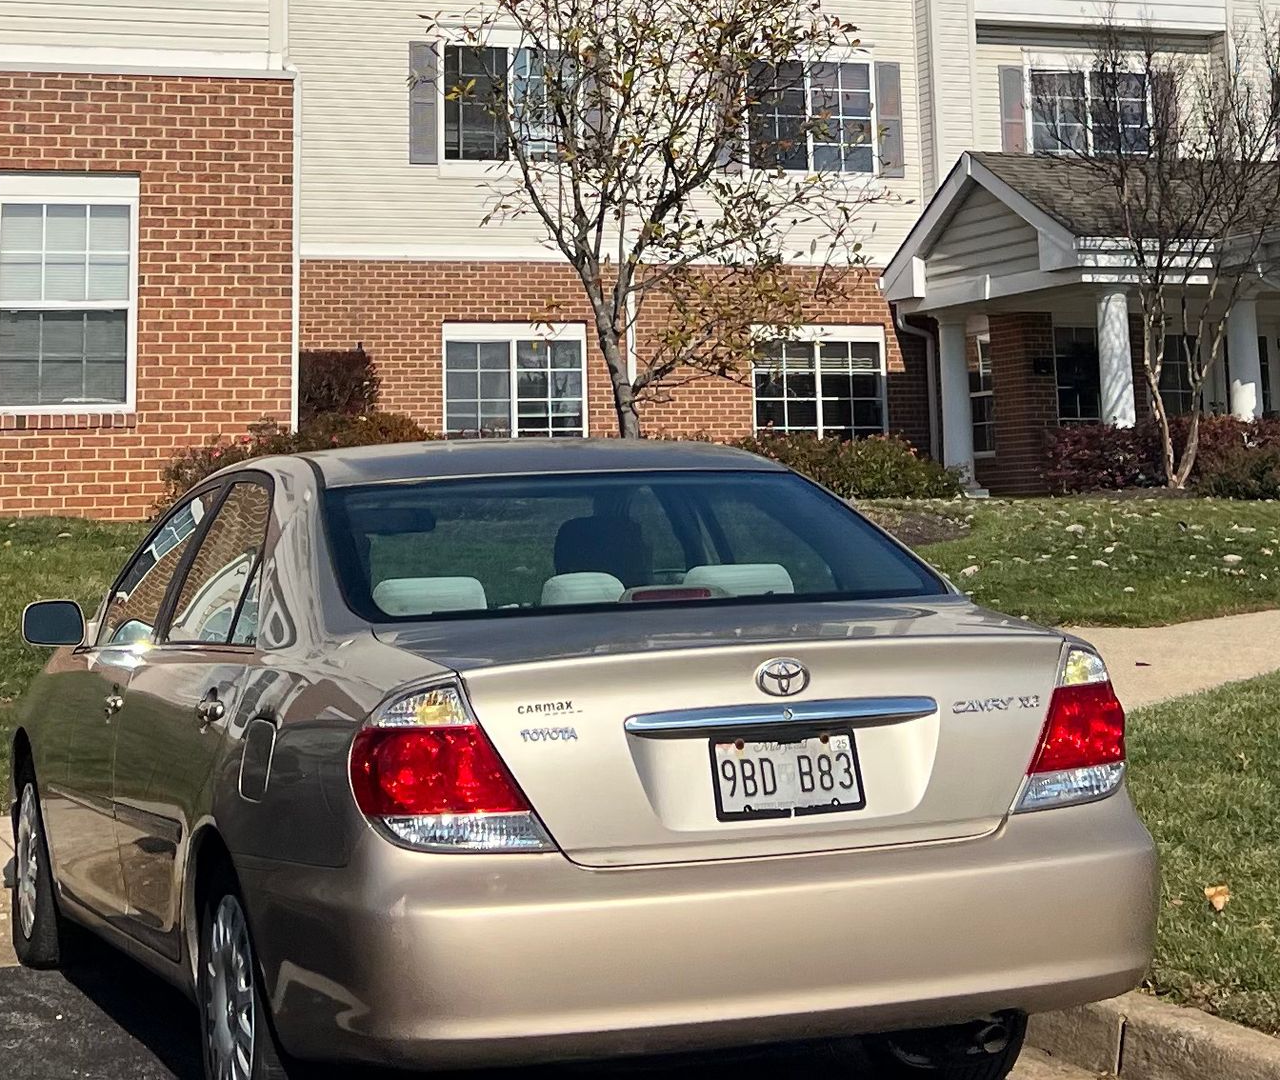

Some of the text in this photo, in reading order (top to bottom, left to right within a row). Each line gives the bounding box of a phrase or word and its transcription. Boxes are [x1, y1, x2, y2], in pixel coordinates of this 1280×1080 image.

[520, 727, 578, 742] TOYOTA
[835, 739, 847, 749] 25
[721, 752, 854, 797] 9BD B83
